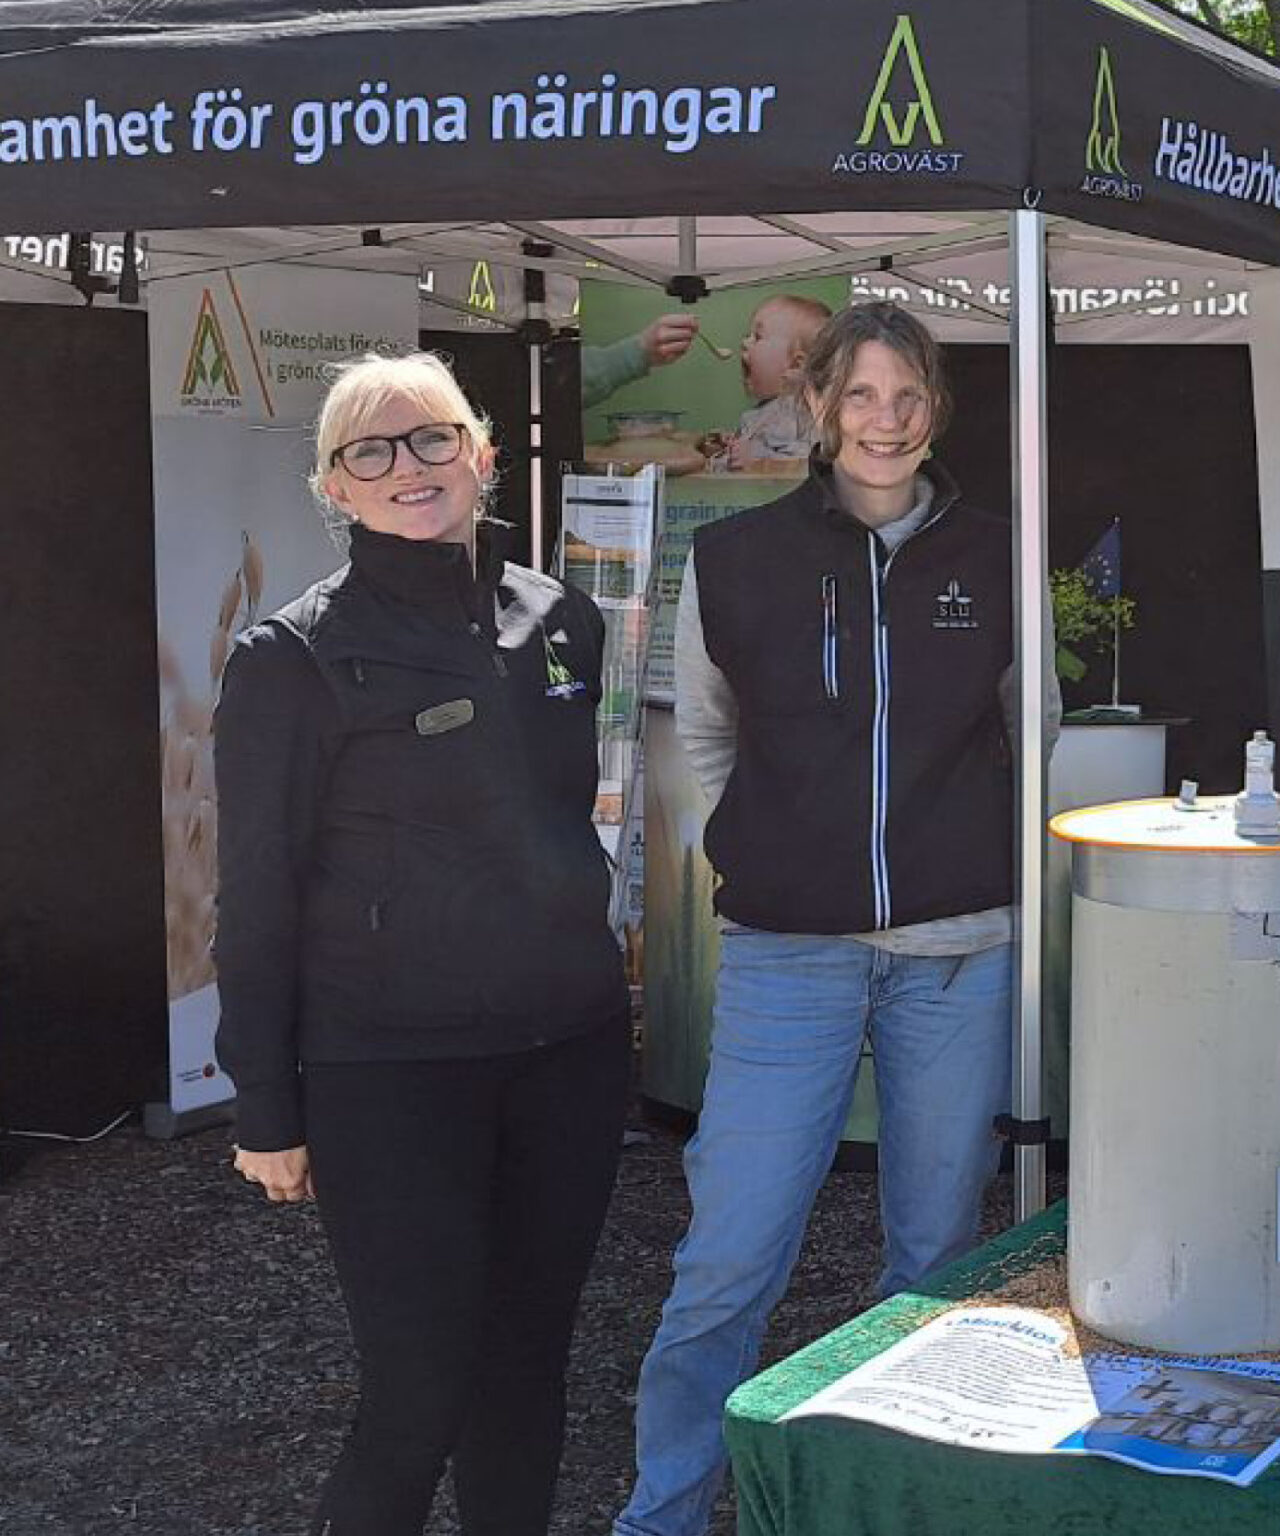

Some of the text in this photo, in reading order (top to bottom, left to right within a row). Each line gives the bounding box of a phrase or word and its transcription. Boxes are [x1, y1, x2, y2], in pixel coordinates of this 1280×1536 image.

[191, 88, 272, 152] för
[291, 82, 467, 164] gröna
[491, 74, 776, 152] näringar
[833, 151, 963, 174] AGROVÄST
[259, 329, 344, 351] Mötesplats
[349, 332, 370, 351] för
[939, 604, 970, 617] SLU
